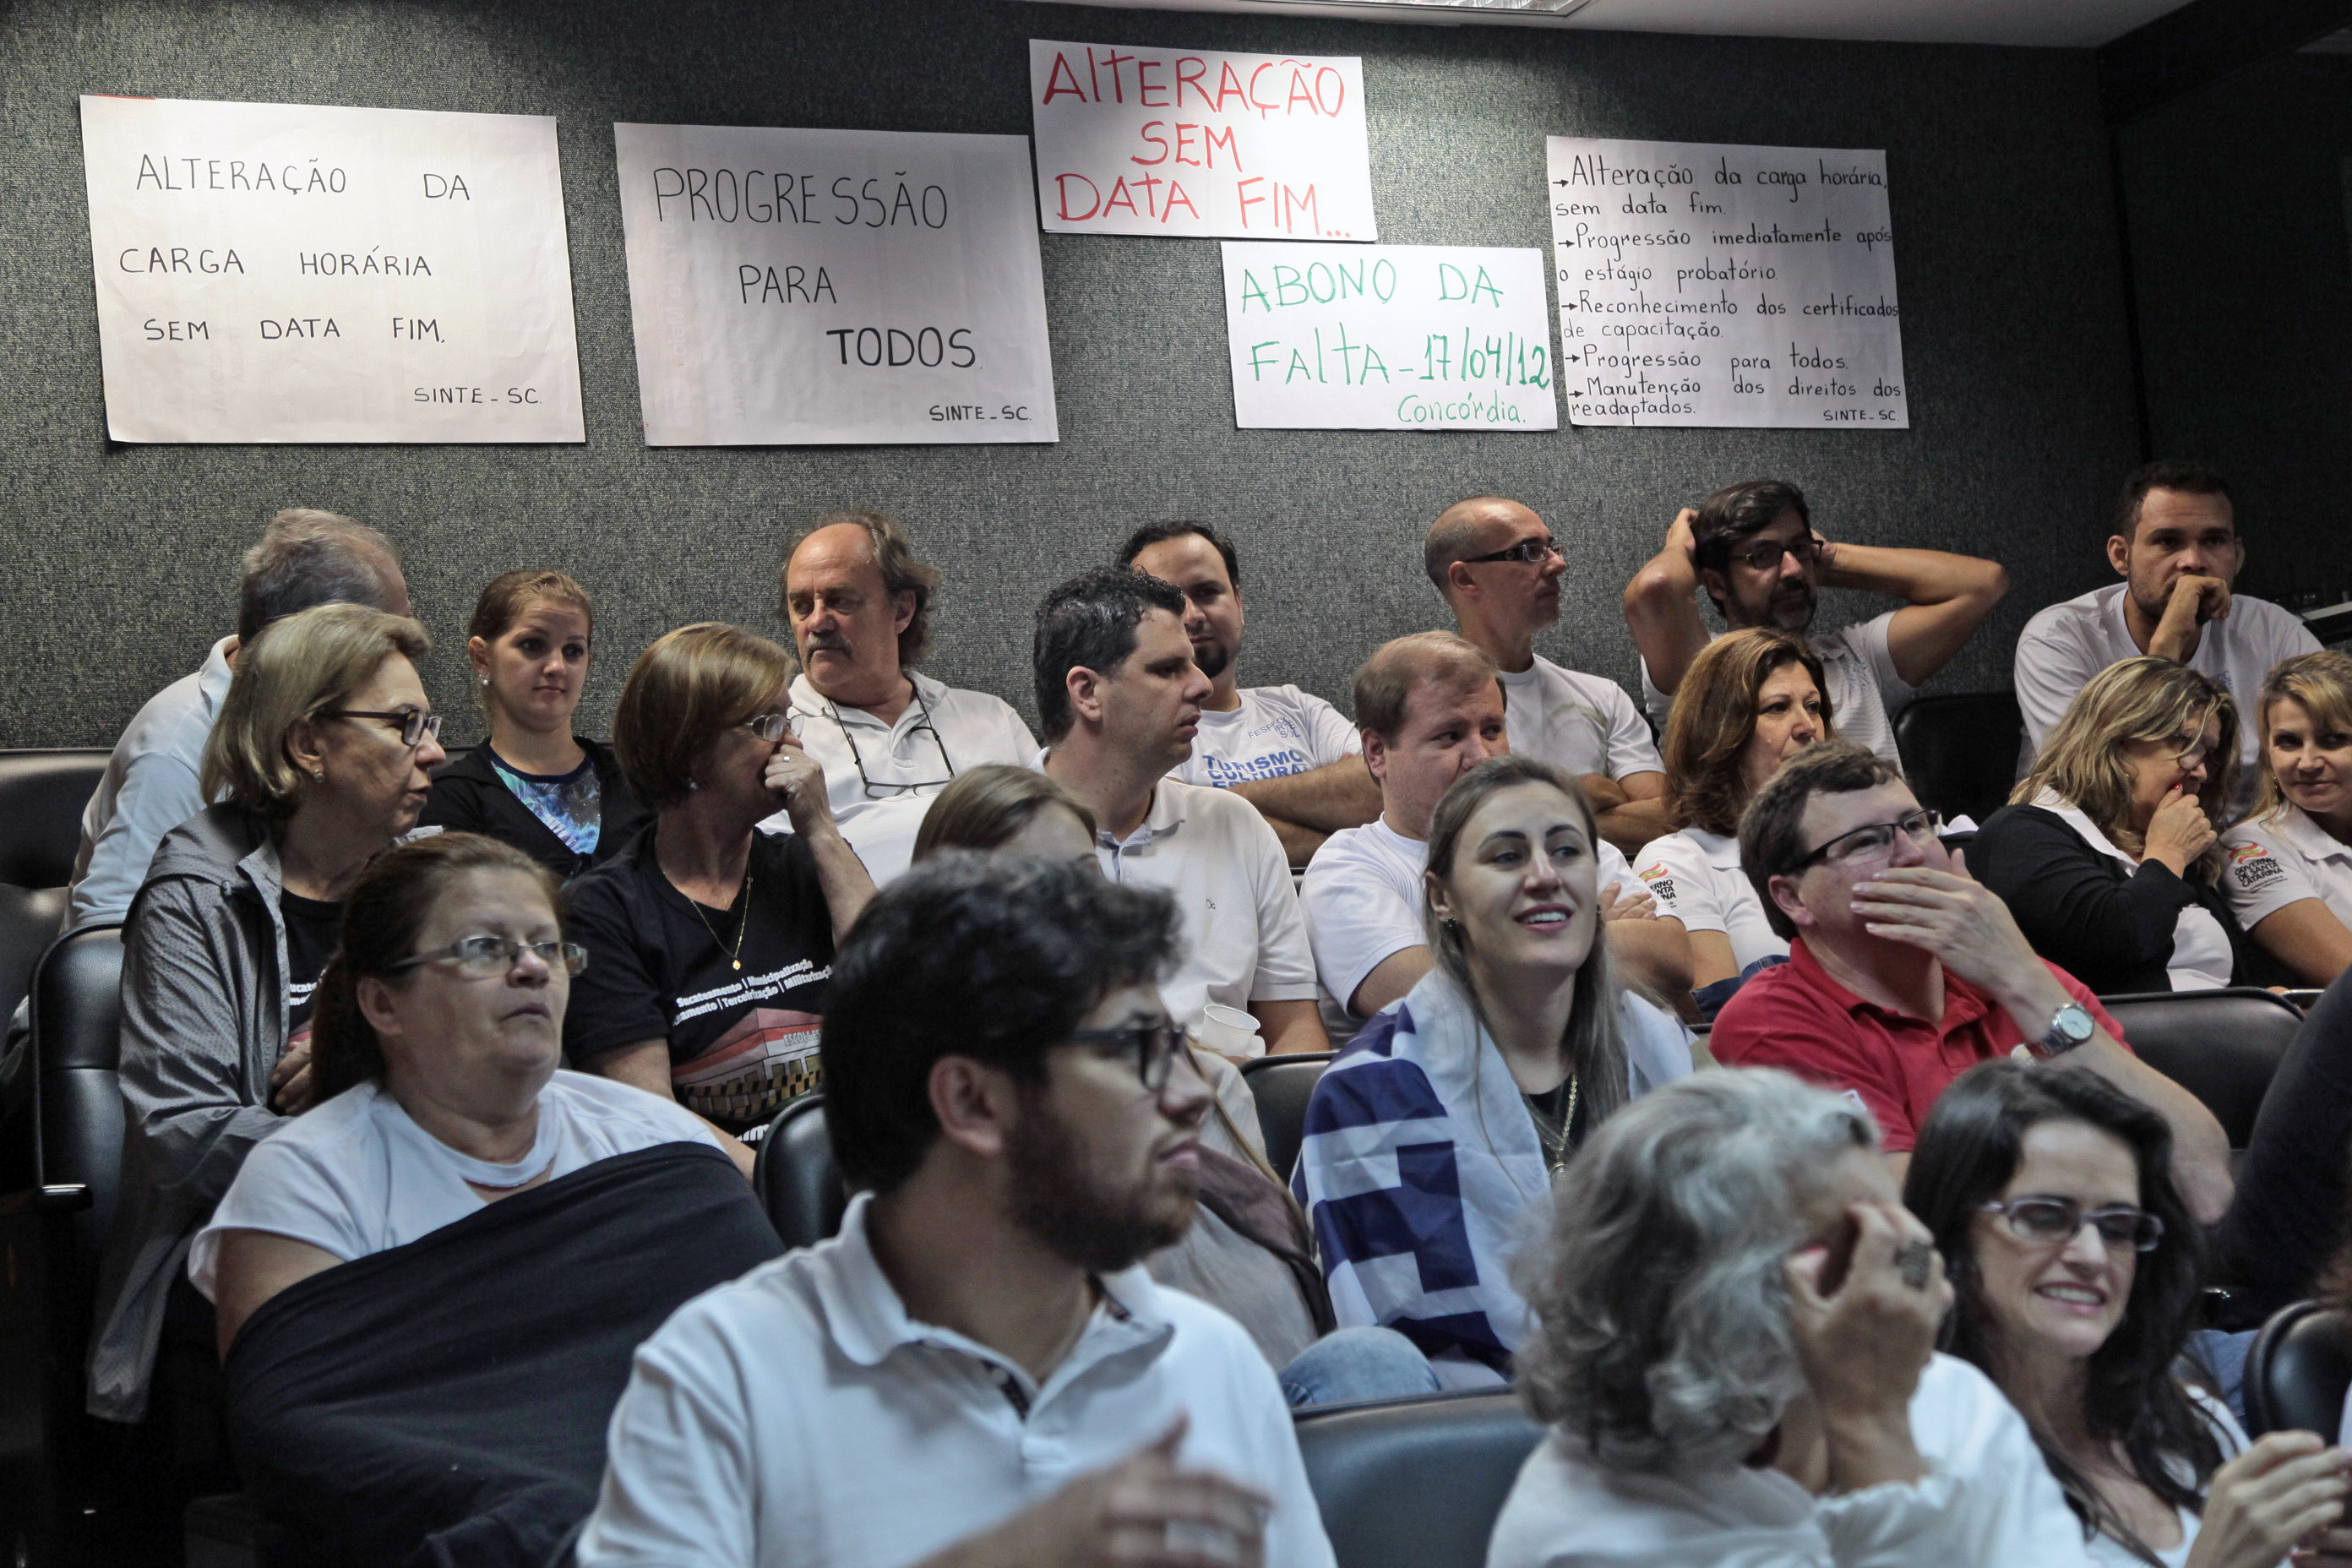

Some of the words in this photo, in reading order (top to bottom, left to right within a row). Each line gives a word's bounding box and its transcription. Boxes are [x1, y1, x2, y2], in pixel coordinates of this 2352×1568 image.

[1130, 120, 1244, 173] SEM
[136, 153, 346, 196] ALTERAÇÃO
[422, 173, 471, 201] DA
[1571, 154, 1694, 189] Alteração
[1714, 155, 1743, 186] da
[1756, 171, 1807, 204] carga
[652, 167, 948, 230] PROGRESSÃO
[1054, 171, 1200, 224] DATA
[1554, 203, 1601, 216] sem
[1621, 191, 1669, 215] data
[1576, 221, 1691, 263] Progressão
[1712, 217, 1842, 245] imediatamente
[1856, 226, 1892, 253] após
[119, 246, 245, 275] CARGA
[299, 244, 433, 277] HORÁRIA
[1559, 269, 1569, 282] o
[1584, 258, 1652, 292] estágio
[738, 264, 837, 305] PARA
[1240, 258, 1397, 314] ABONO
[1437, 262, 1505, 309] DA
[1578, 288, 1738, 315] Reconhecimento
[1756, 291, 1787, 316] dos
[1802, 292, 1899, 318] certificados
[143, 318, 210, 341] SEM
[259, 317, 341, 340] DATA
[392, 317, 445, 344] FIM.
[1563, 317, 1586, 339] de
[1601, 315, 1724, 352] capacitação.
[1582, 343, 1701, 379] Progressão
[1730, 357, 1772, 383] para
[1788, 340, 1848, 370] todos.
[1587, 370, 1701, 396] Manutenção
[1733, 373, 1765, 395] dos
[1788, 375, 1857, 396] direitos
[1872, 376, 1902, 398] dos
[1571, 393, 1696, 425] readaptados.
[1650, 879, 1674, 890] ERNO
[2242, 867, 2284, 887] CATARINA
[2250, 861, 2279, 875] SANTA
[676, 982, 743, 1008] Sucateamento
